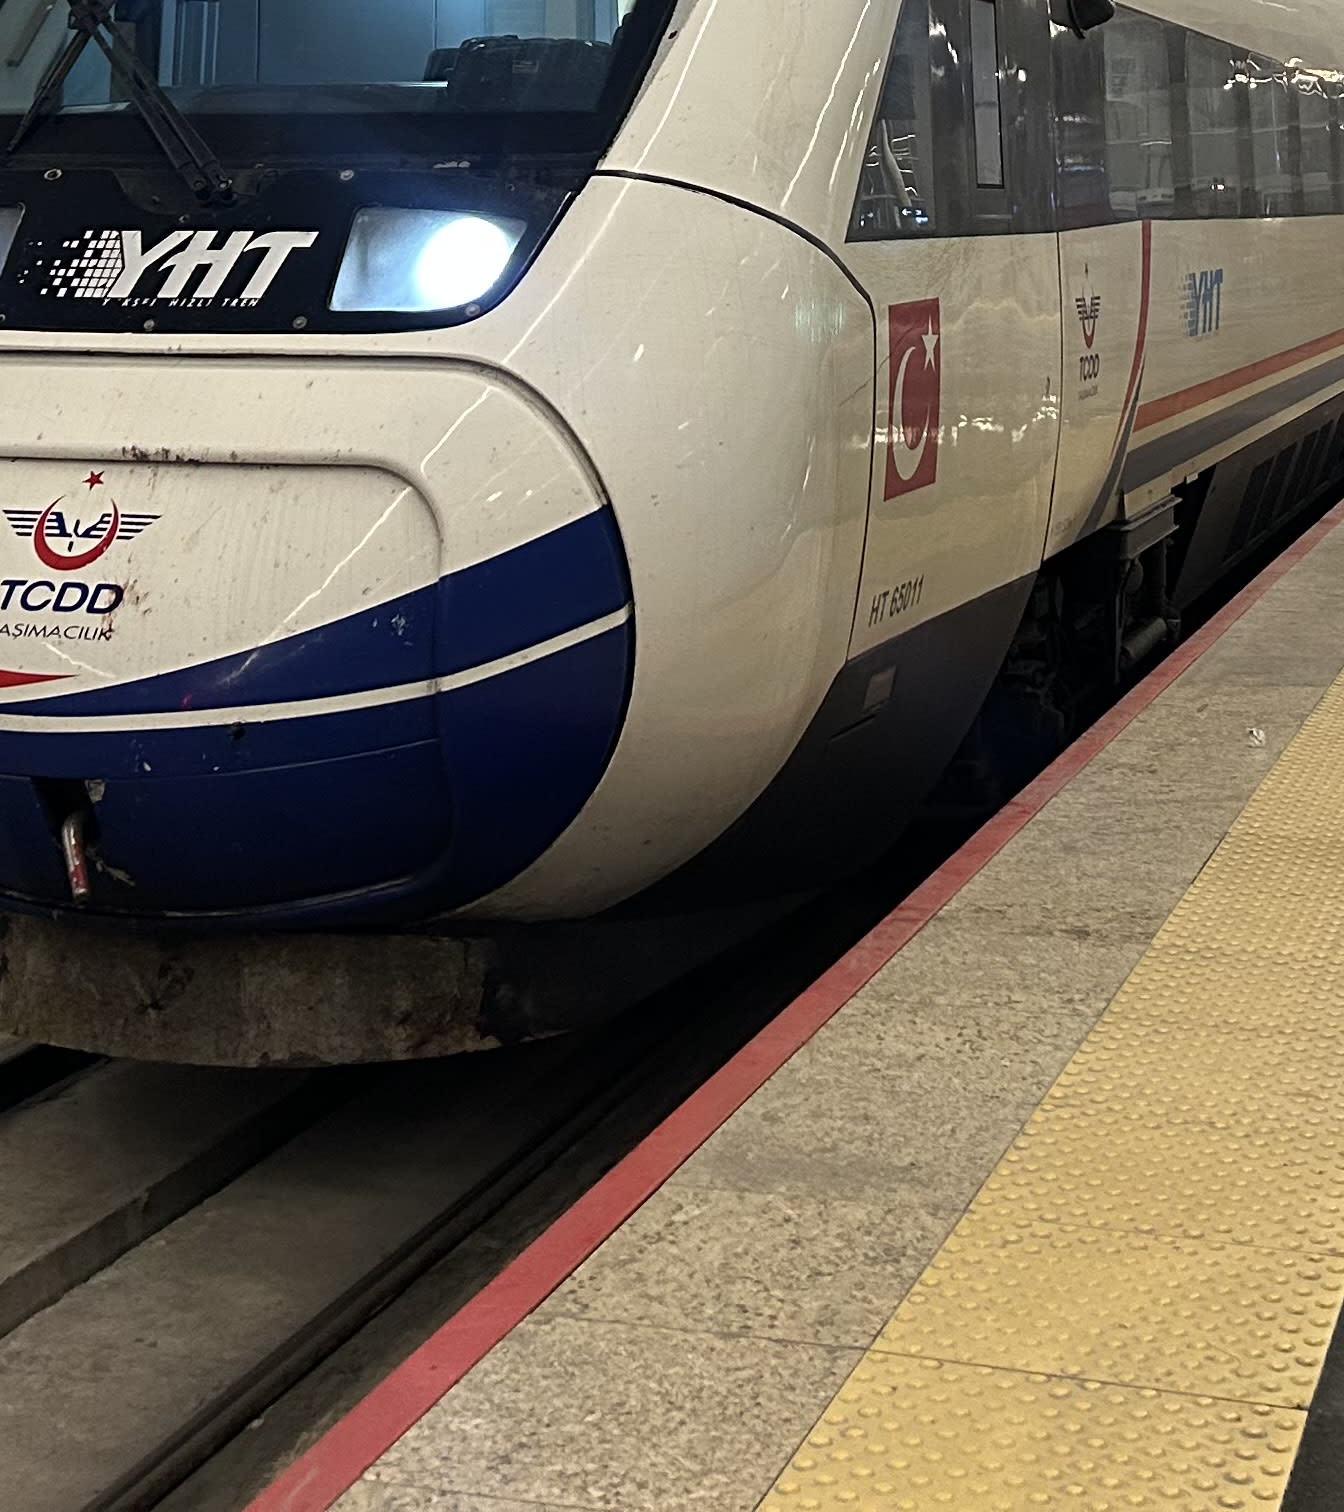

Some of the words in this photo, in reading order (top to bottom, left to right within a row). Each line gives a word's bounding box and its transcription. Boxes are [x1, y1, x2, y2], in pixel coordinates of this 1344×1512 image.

[106, 230, 320, 299] YHT
[1191, 268, 1223, 336] YHT
[0, 580, 124, 614] TCDD
[868, 590, 890, 628] HT
[890, 574, 924, 616] 65011
